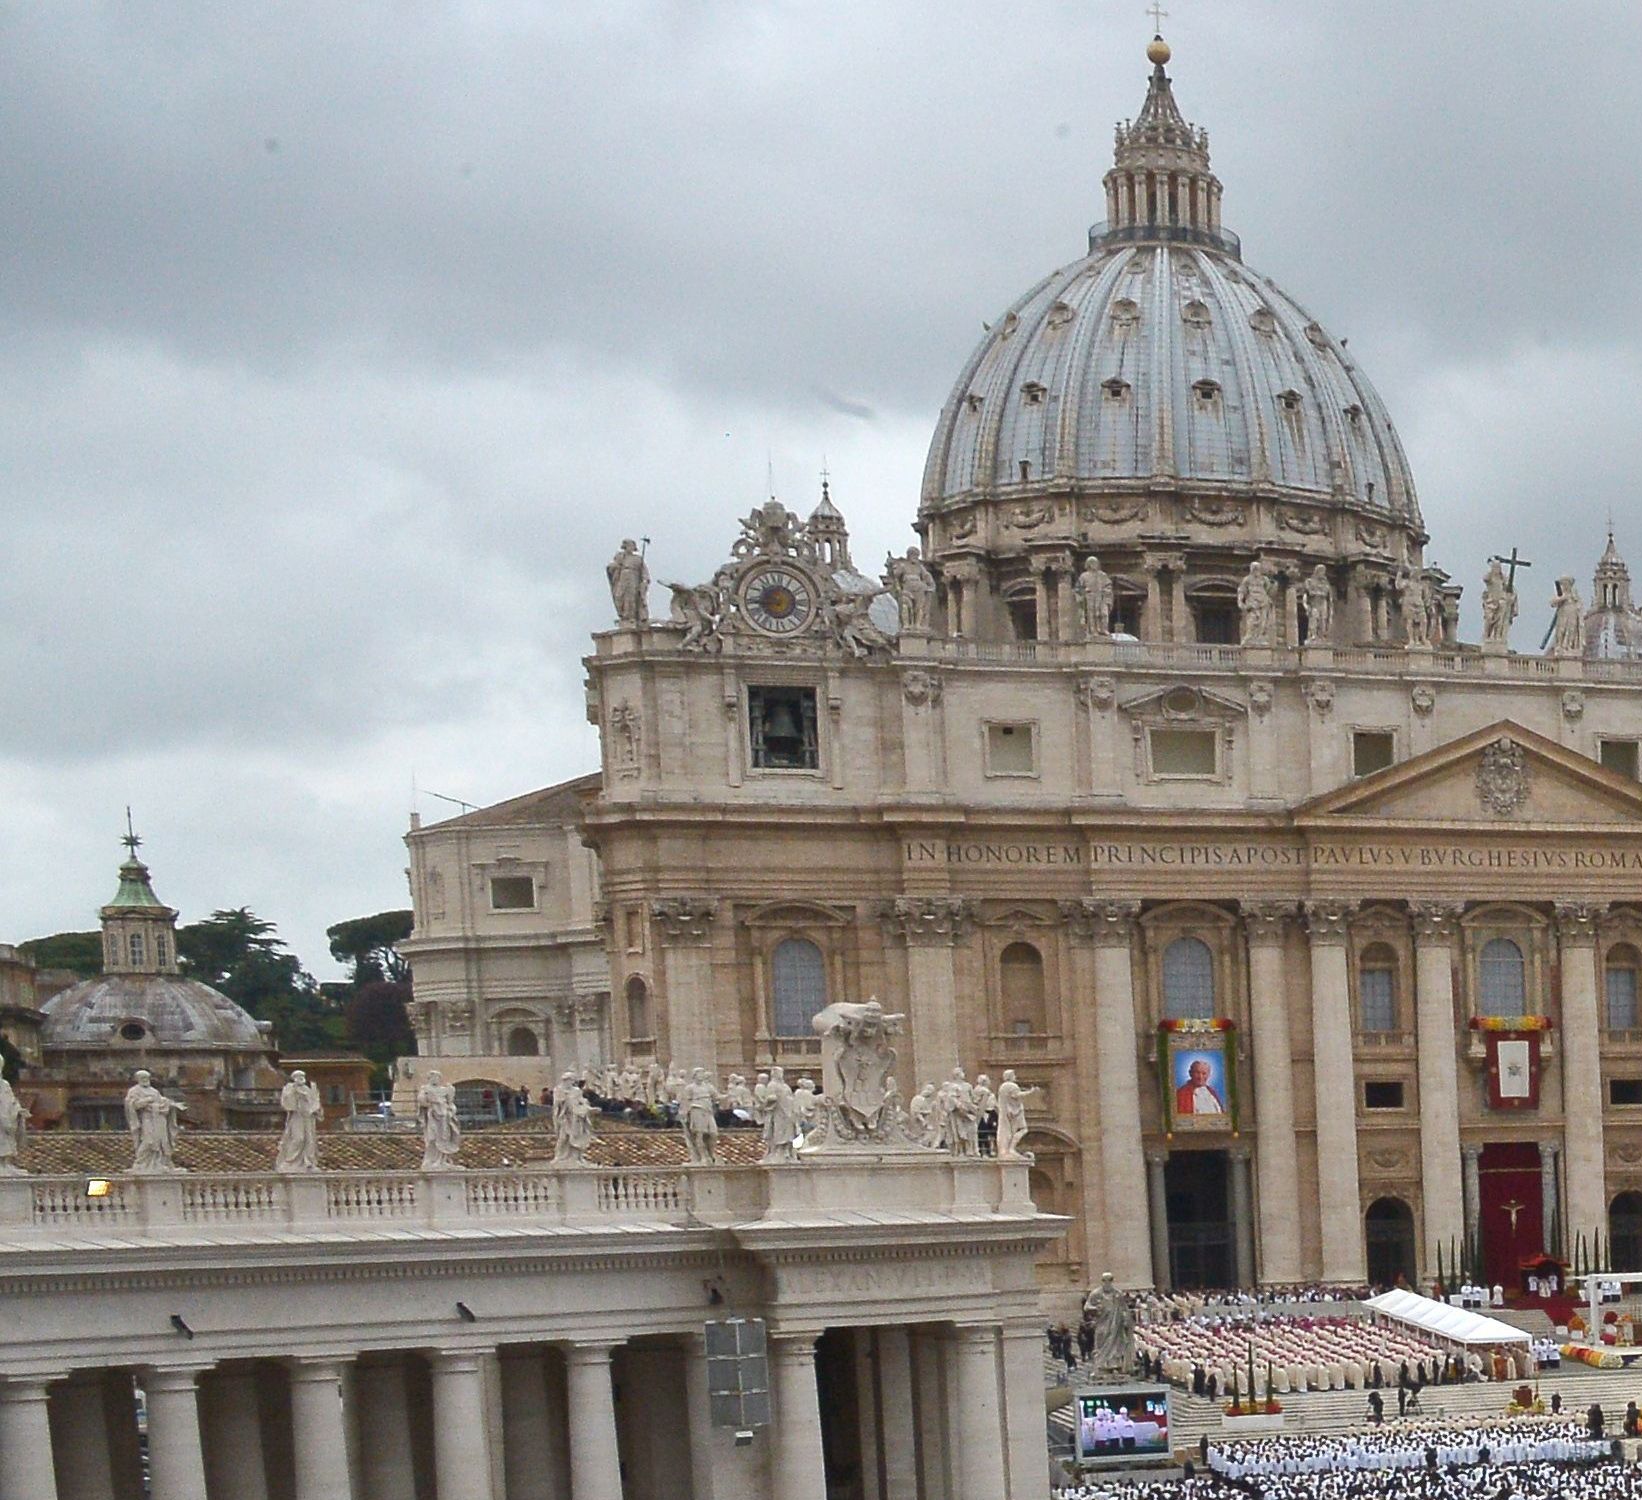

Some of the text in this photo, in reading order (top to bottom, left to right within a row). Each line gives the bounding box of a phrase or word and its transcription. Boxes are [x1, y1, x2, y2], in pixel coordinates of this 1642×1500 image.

[906, 843, 936, 862] IN
[945, 844, 1083, 864] HONOREM
[1093, 845, 1223, 865] PRINCIPIS
[1228, 846, 1307, 866] APOST
[1312, 847, 1395, 865] PAVLVS
[1400, 847, 1411, 864] V
[1420, 847, 1566, 869] BVRGHESIVS
